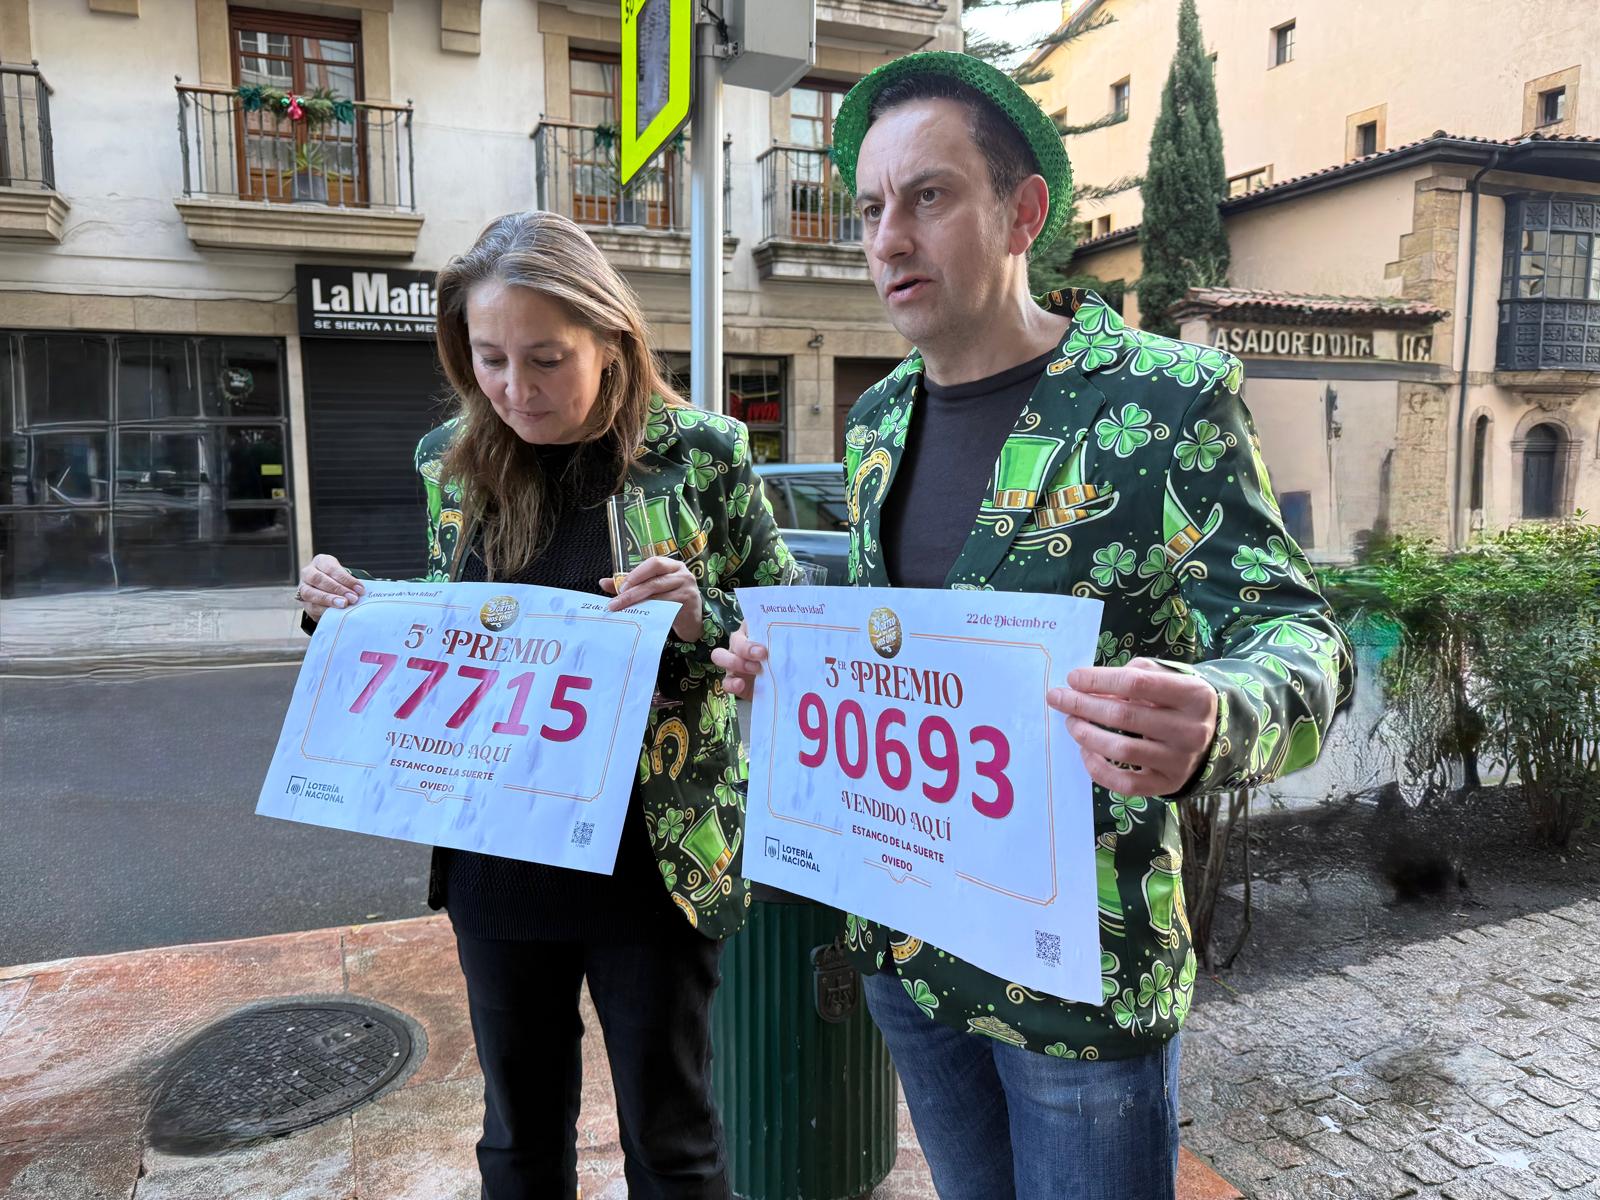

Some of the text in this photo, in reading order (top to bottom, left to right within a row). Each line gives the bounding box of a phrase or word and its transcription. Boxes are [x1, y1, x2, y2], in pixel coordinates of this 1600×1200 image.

[314, 319, 331, 330] SE
[335, 320, 380, 332] SIENTA
[383, 322, 393, 332] A
[395, 323, 413, 333] LA
[1214, 327, 1304, 355] ASADOR
[966, 613, 1057, 630] 22 de Diciembre
[441, 628, 562, 666] PREMIO
[349, 650, 593, 742] 77715
[850, 660, 963, 709] PREMIO
[385, 731, 513, 764] VENDIDO AQUÍ
[797, 691, 1014, 820] 90693
[390, 758, 495, 781] ESTANCO DE LA SUERTE
[304, 789, 345, 804] NACIONAL
[419, 780, 455, 793] OVIEDO
[841, 790, 952, 842] VENDIDO AQUÍ
[782, 844, 814, 861] LOTERÍA
[852, 824, 945, 864] ESTANCO DE LA SUERTE
[781, 853, 821, 873] NACIONAL
[881, 853, 913, 872] OVIEDO
